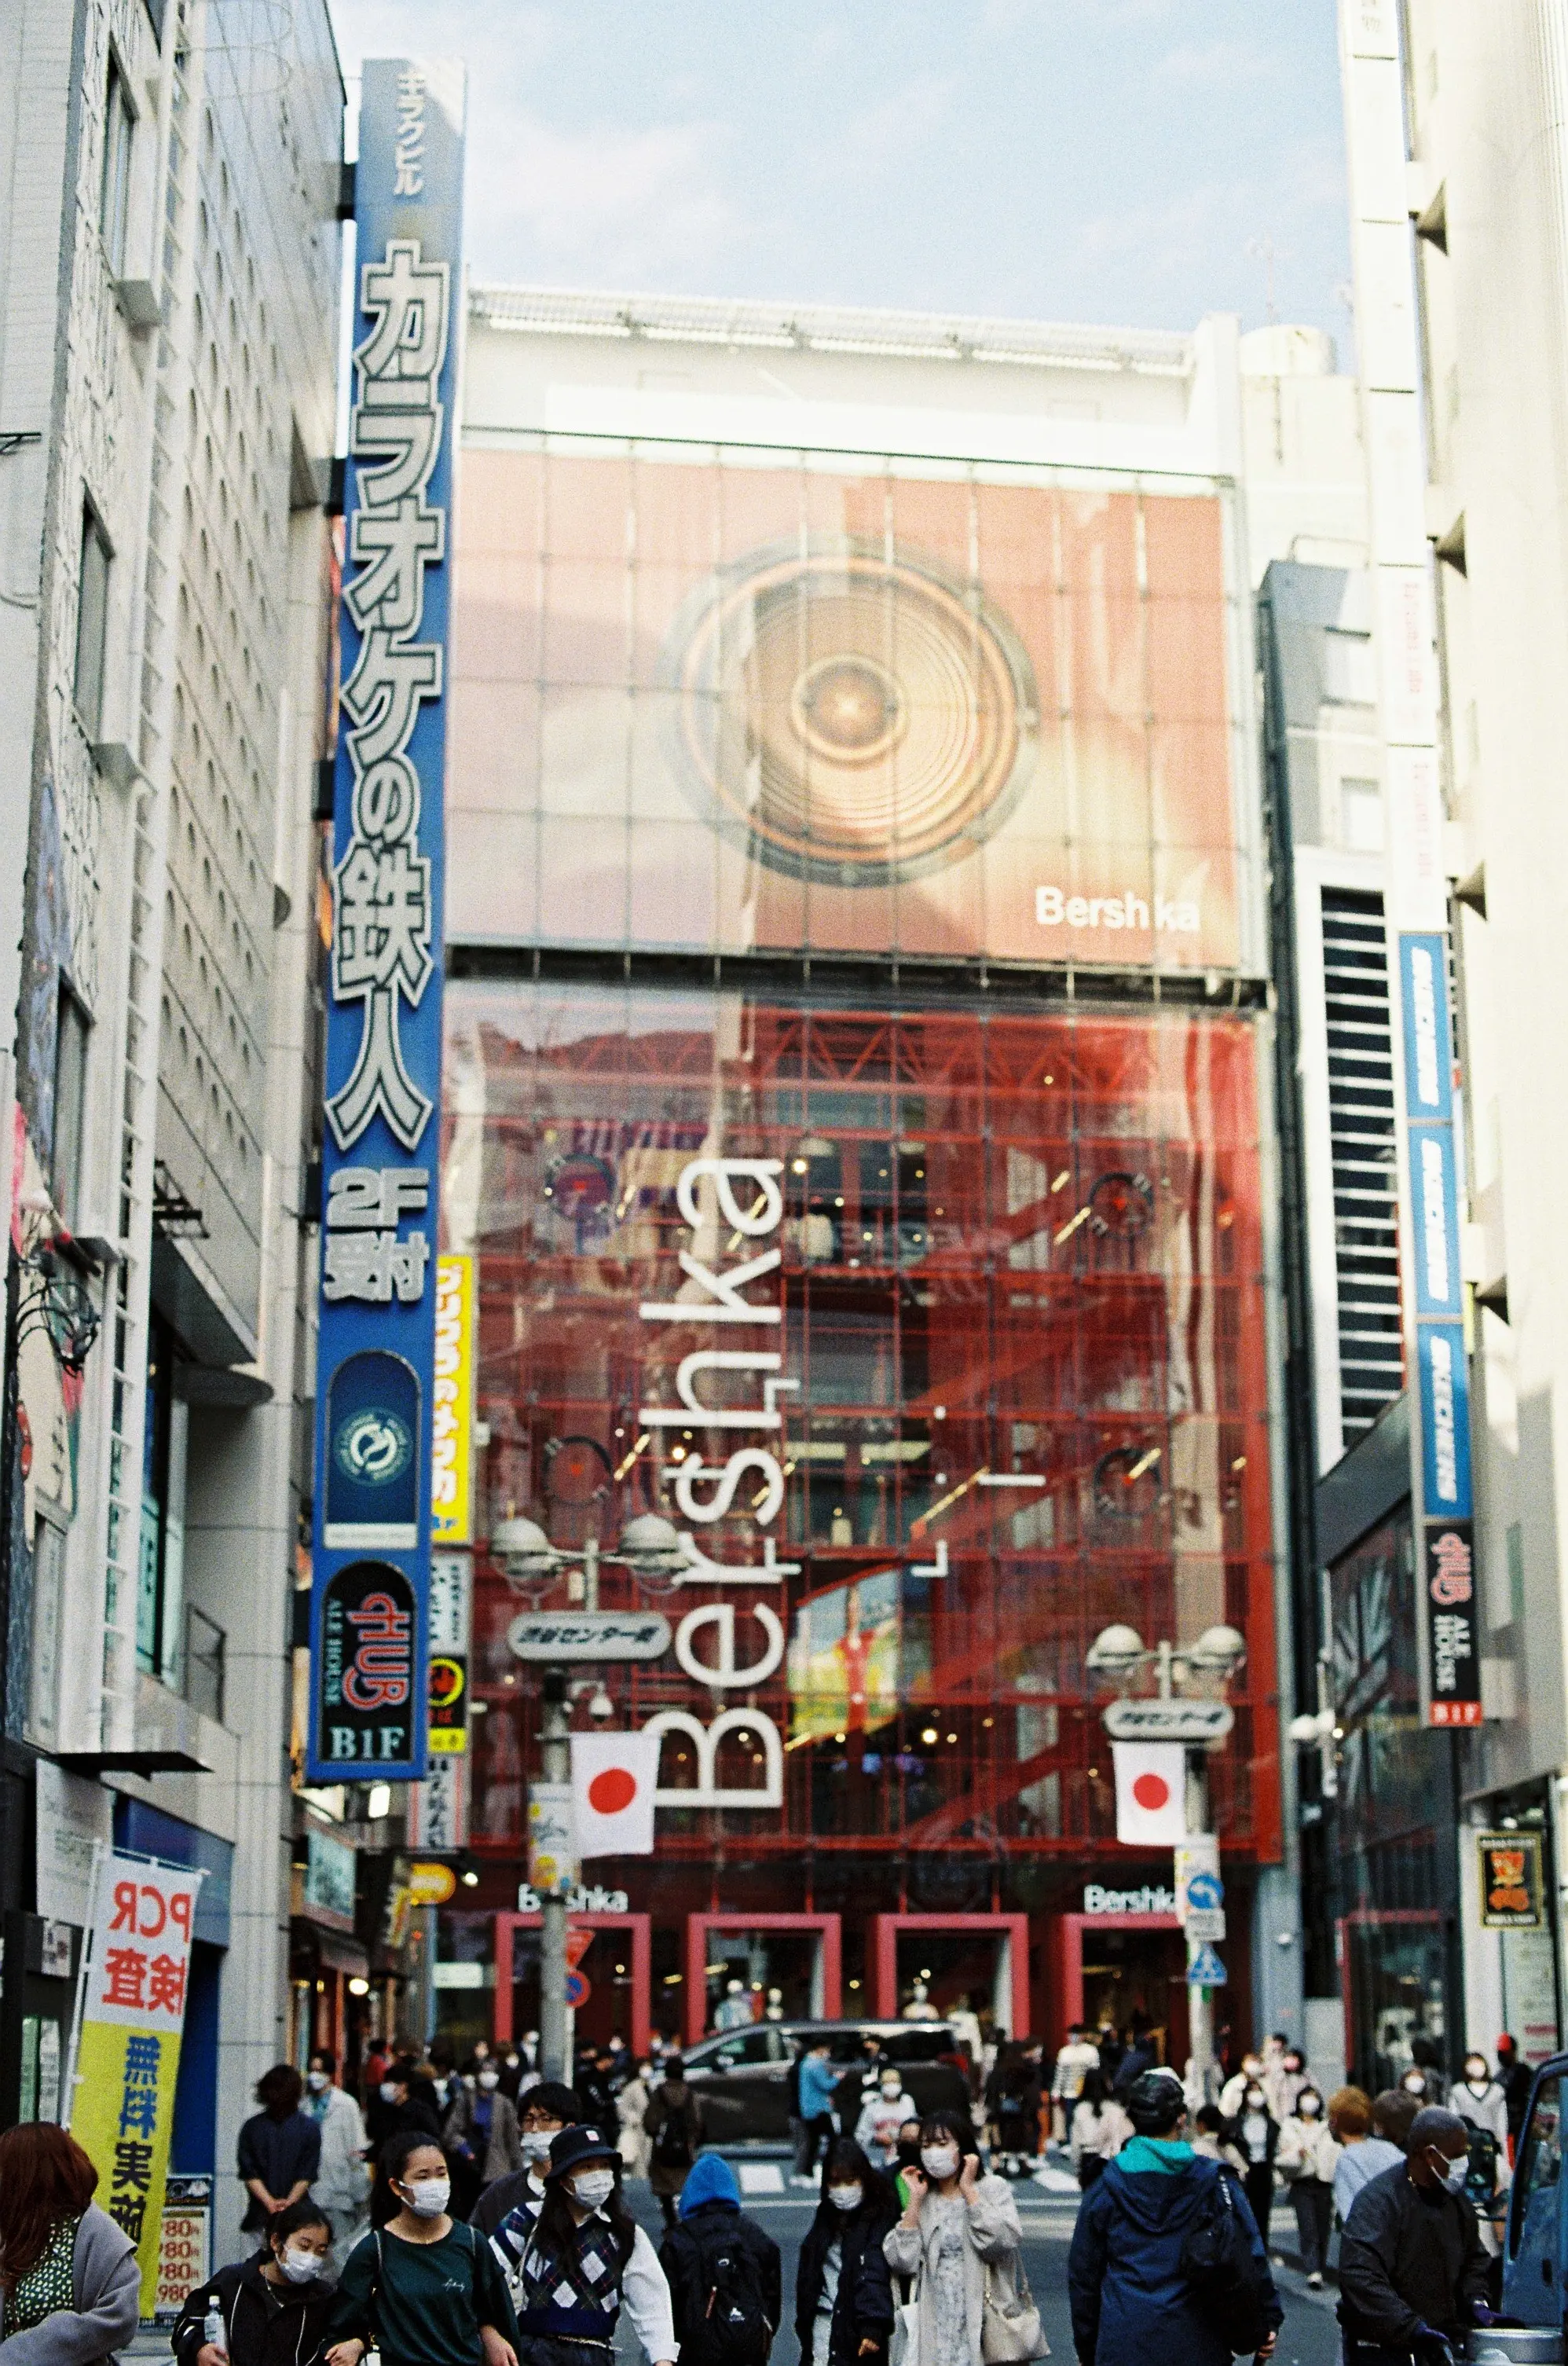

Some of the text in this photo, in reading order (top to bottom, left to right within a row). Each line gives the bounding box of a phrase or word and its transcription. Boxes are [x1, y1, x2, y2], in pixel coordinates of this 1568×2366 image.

[323, 240, 449, 1150] カラオケの鉄人
[1035, 886, 1201, 931] Bershka
[326, 1168, 429, 1227] 2F
[323, 1231, 430, 1302] 受付
[639, 1157, 783, 1809] Bershka
[1430, 1532, 1473, 1605] HUB
[342, 1593, 410, 1711] HUB
[331, 1727, 405, 1760] B1F
[1083, 1884, 1175, 1913] Bershk
